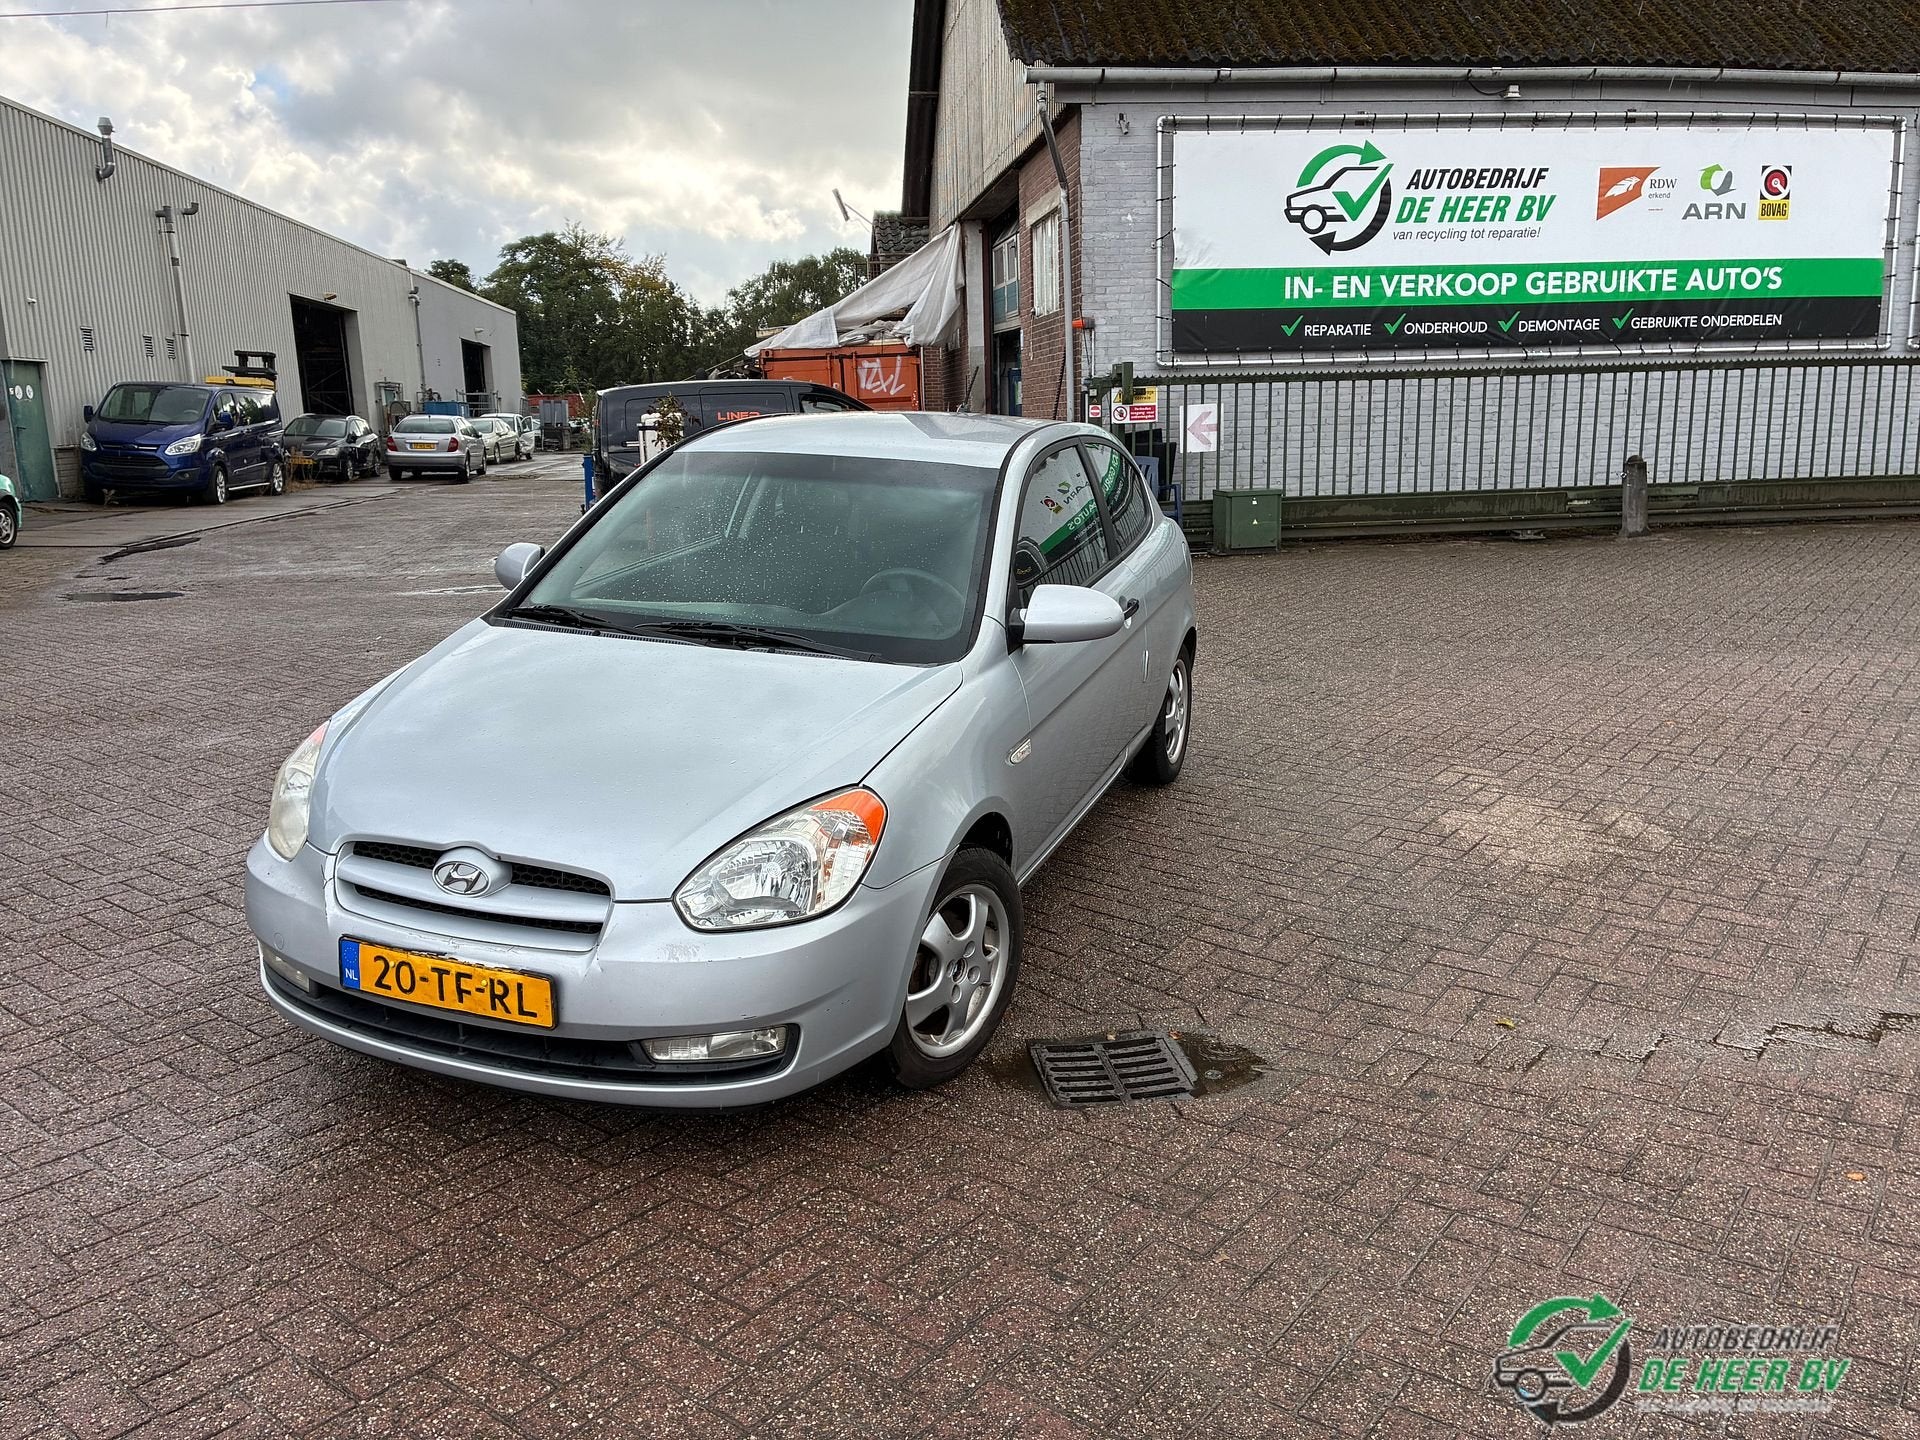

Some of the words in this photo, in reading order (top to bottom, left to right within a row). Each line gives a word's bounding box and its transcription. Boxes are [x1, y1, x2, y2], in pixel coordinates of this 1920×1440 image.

[1406, 167, 1550, 190] AUTOBEDRIJF
[1649, 178, 1678, 189] RDW
[1395, 196, 1435, 223] DE
[1438, 195, 1512, 223] HEER
[1515, 194, 1557, 222] BV
[1681, 202, 1747, 220] ARN
[1760, 203, 1788, 217] BOVAG
[1393, 231, 1412, 240] van
[1416, 228, 1467, 243] recycling
[1470, 228, 1485, 239] tot
[1487, 227, 1541, 242] reparatie!
[1285, 276, 1323, 300] IN-
[1332, 275, 1371, 299] EN
[1380, 272, 1518, 298] VERKOOP
[1525, 268, 1678, 295] GEBRUIKTE
[1685, 266, 1784, 292] AUTO'S
[1304, 323, 1372, 337] REPARATIE
[1404, 321, 1488, 335] ONDERHOUD
[1518, 318, 1600, 332] DEMONTAGE
[1630, 315, 1698, 330] GEBRUIKTE
[1700, 314, 1783, 328] ONDERDELEN
[345, 968, 358, 981] NL
[373, 954, 538, 1018] 20-TF-RL
